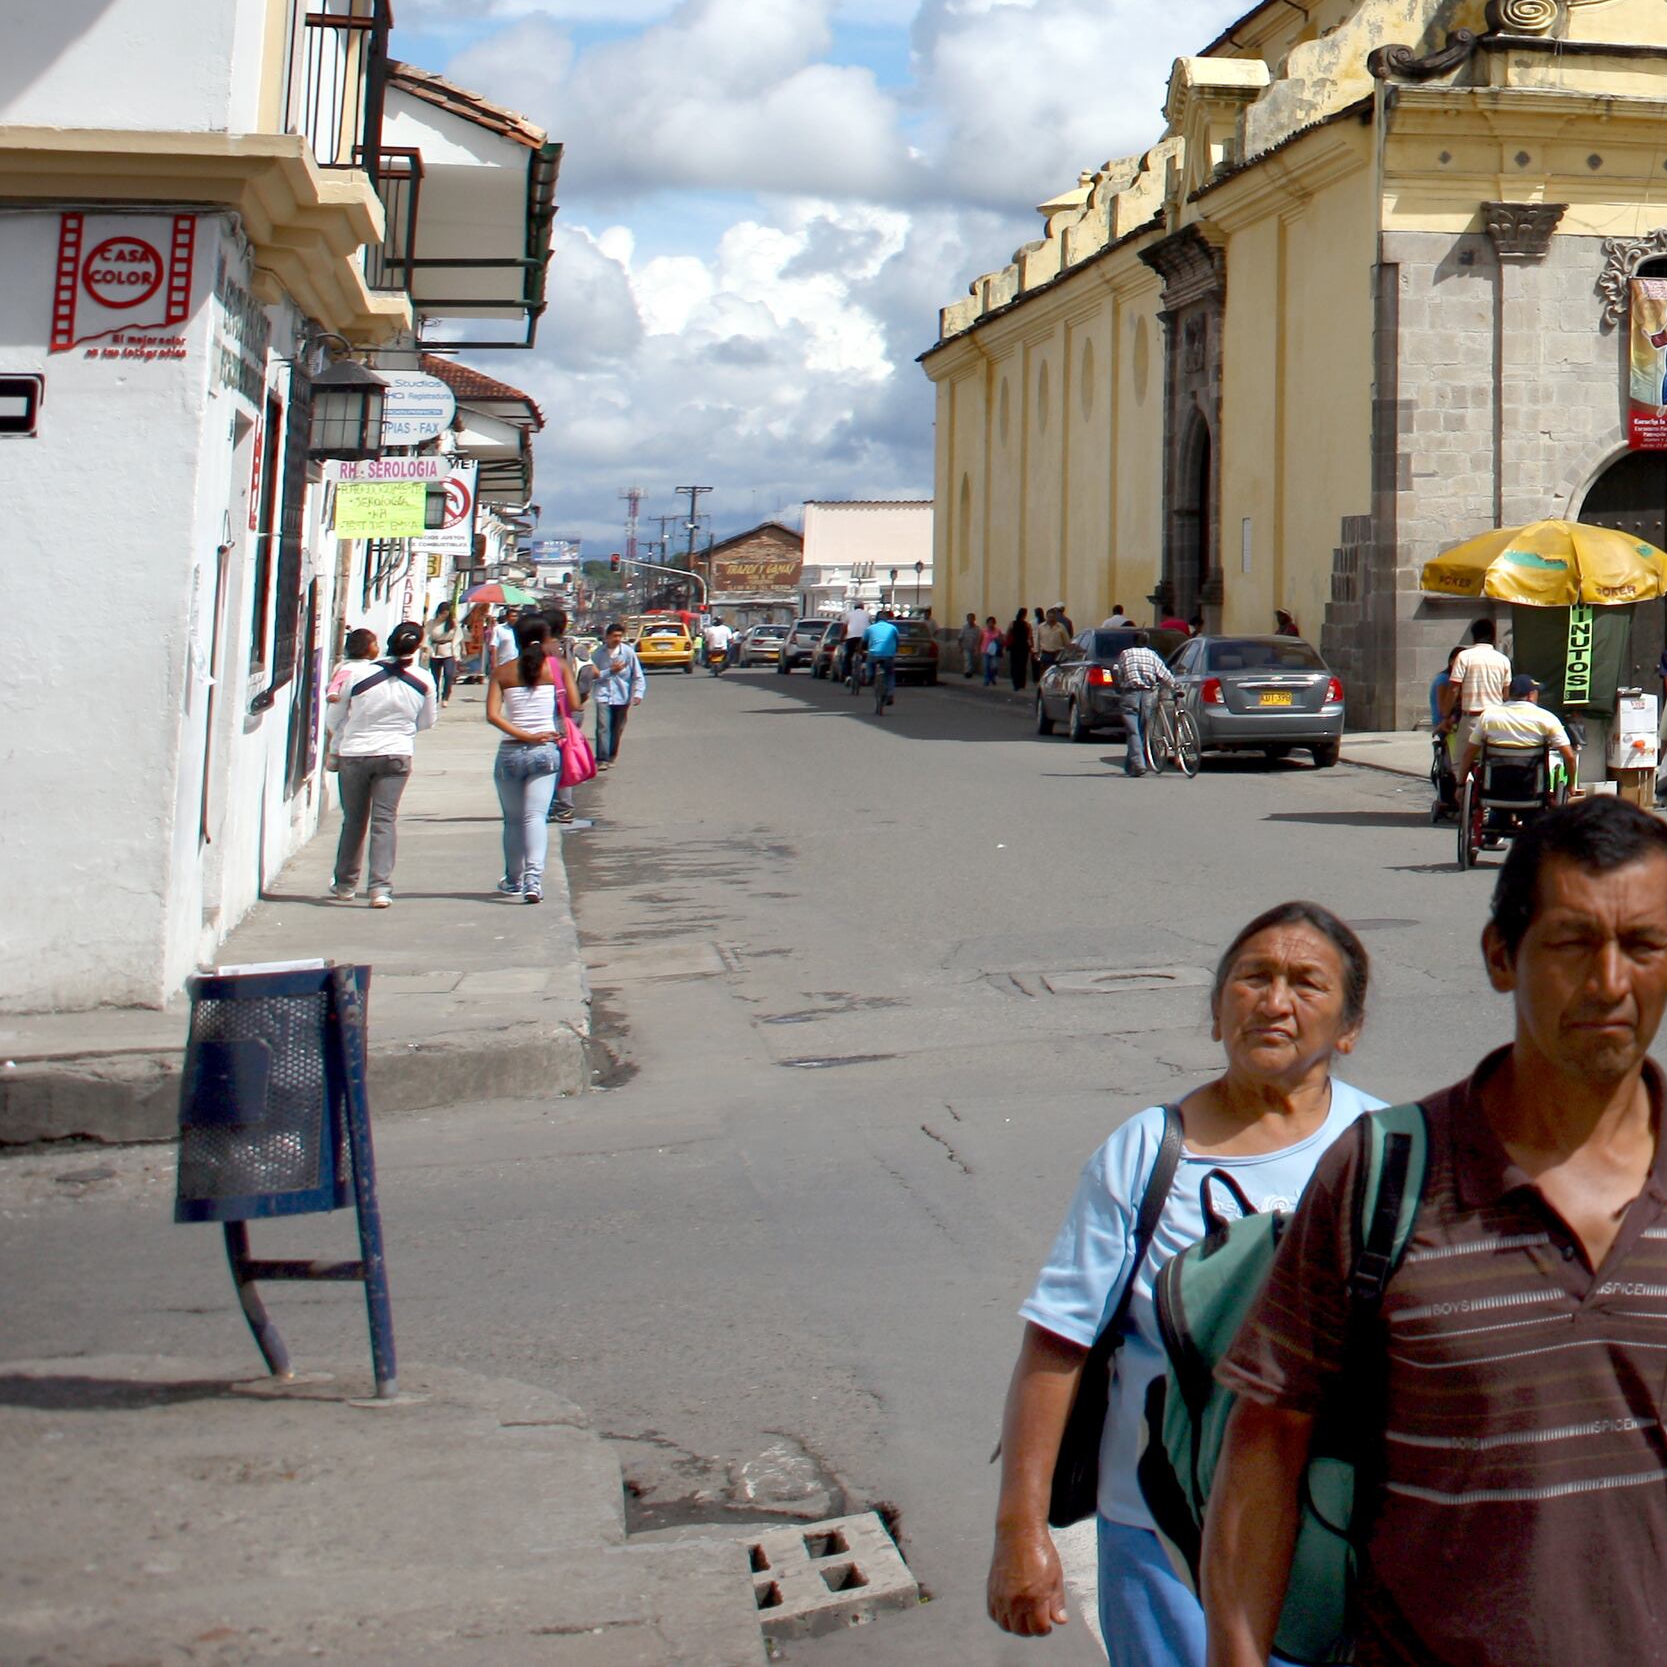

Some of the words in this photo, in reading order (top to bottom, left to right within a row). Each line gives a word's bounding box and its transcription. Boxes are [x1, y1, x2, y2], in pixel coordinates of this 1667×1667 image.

[101, 248, 151, 263] CASA
[90, 270, 153, 284] COLOR
[395, 379, 442, 387] Studios
[420, 423, 438, 433] FAX
[340, 463, 357, 479] RH
[368, 461, 437, 478] SEROLOGIA
[1439, 574, 1471, 589] POKER
[1433, 1300, 1470, 1316] BOYS
[1604, 1282, 1644, 1296] SPICE
[1594, 1419, 1633, 1433] SPICE
